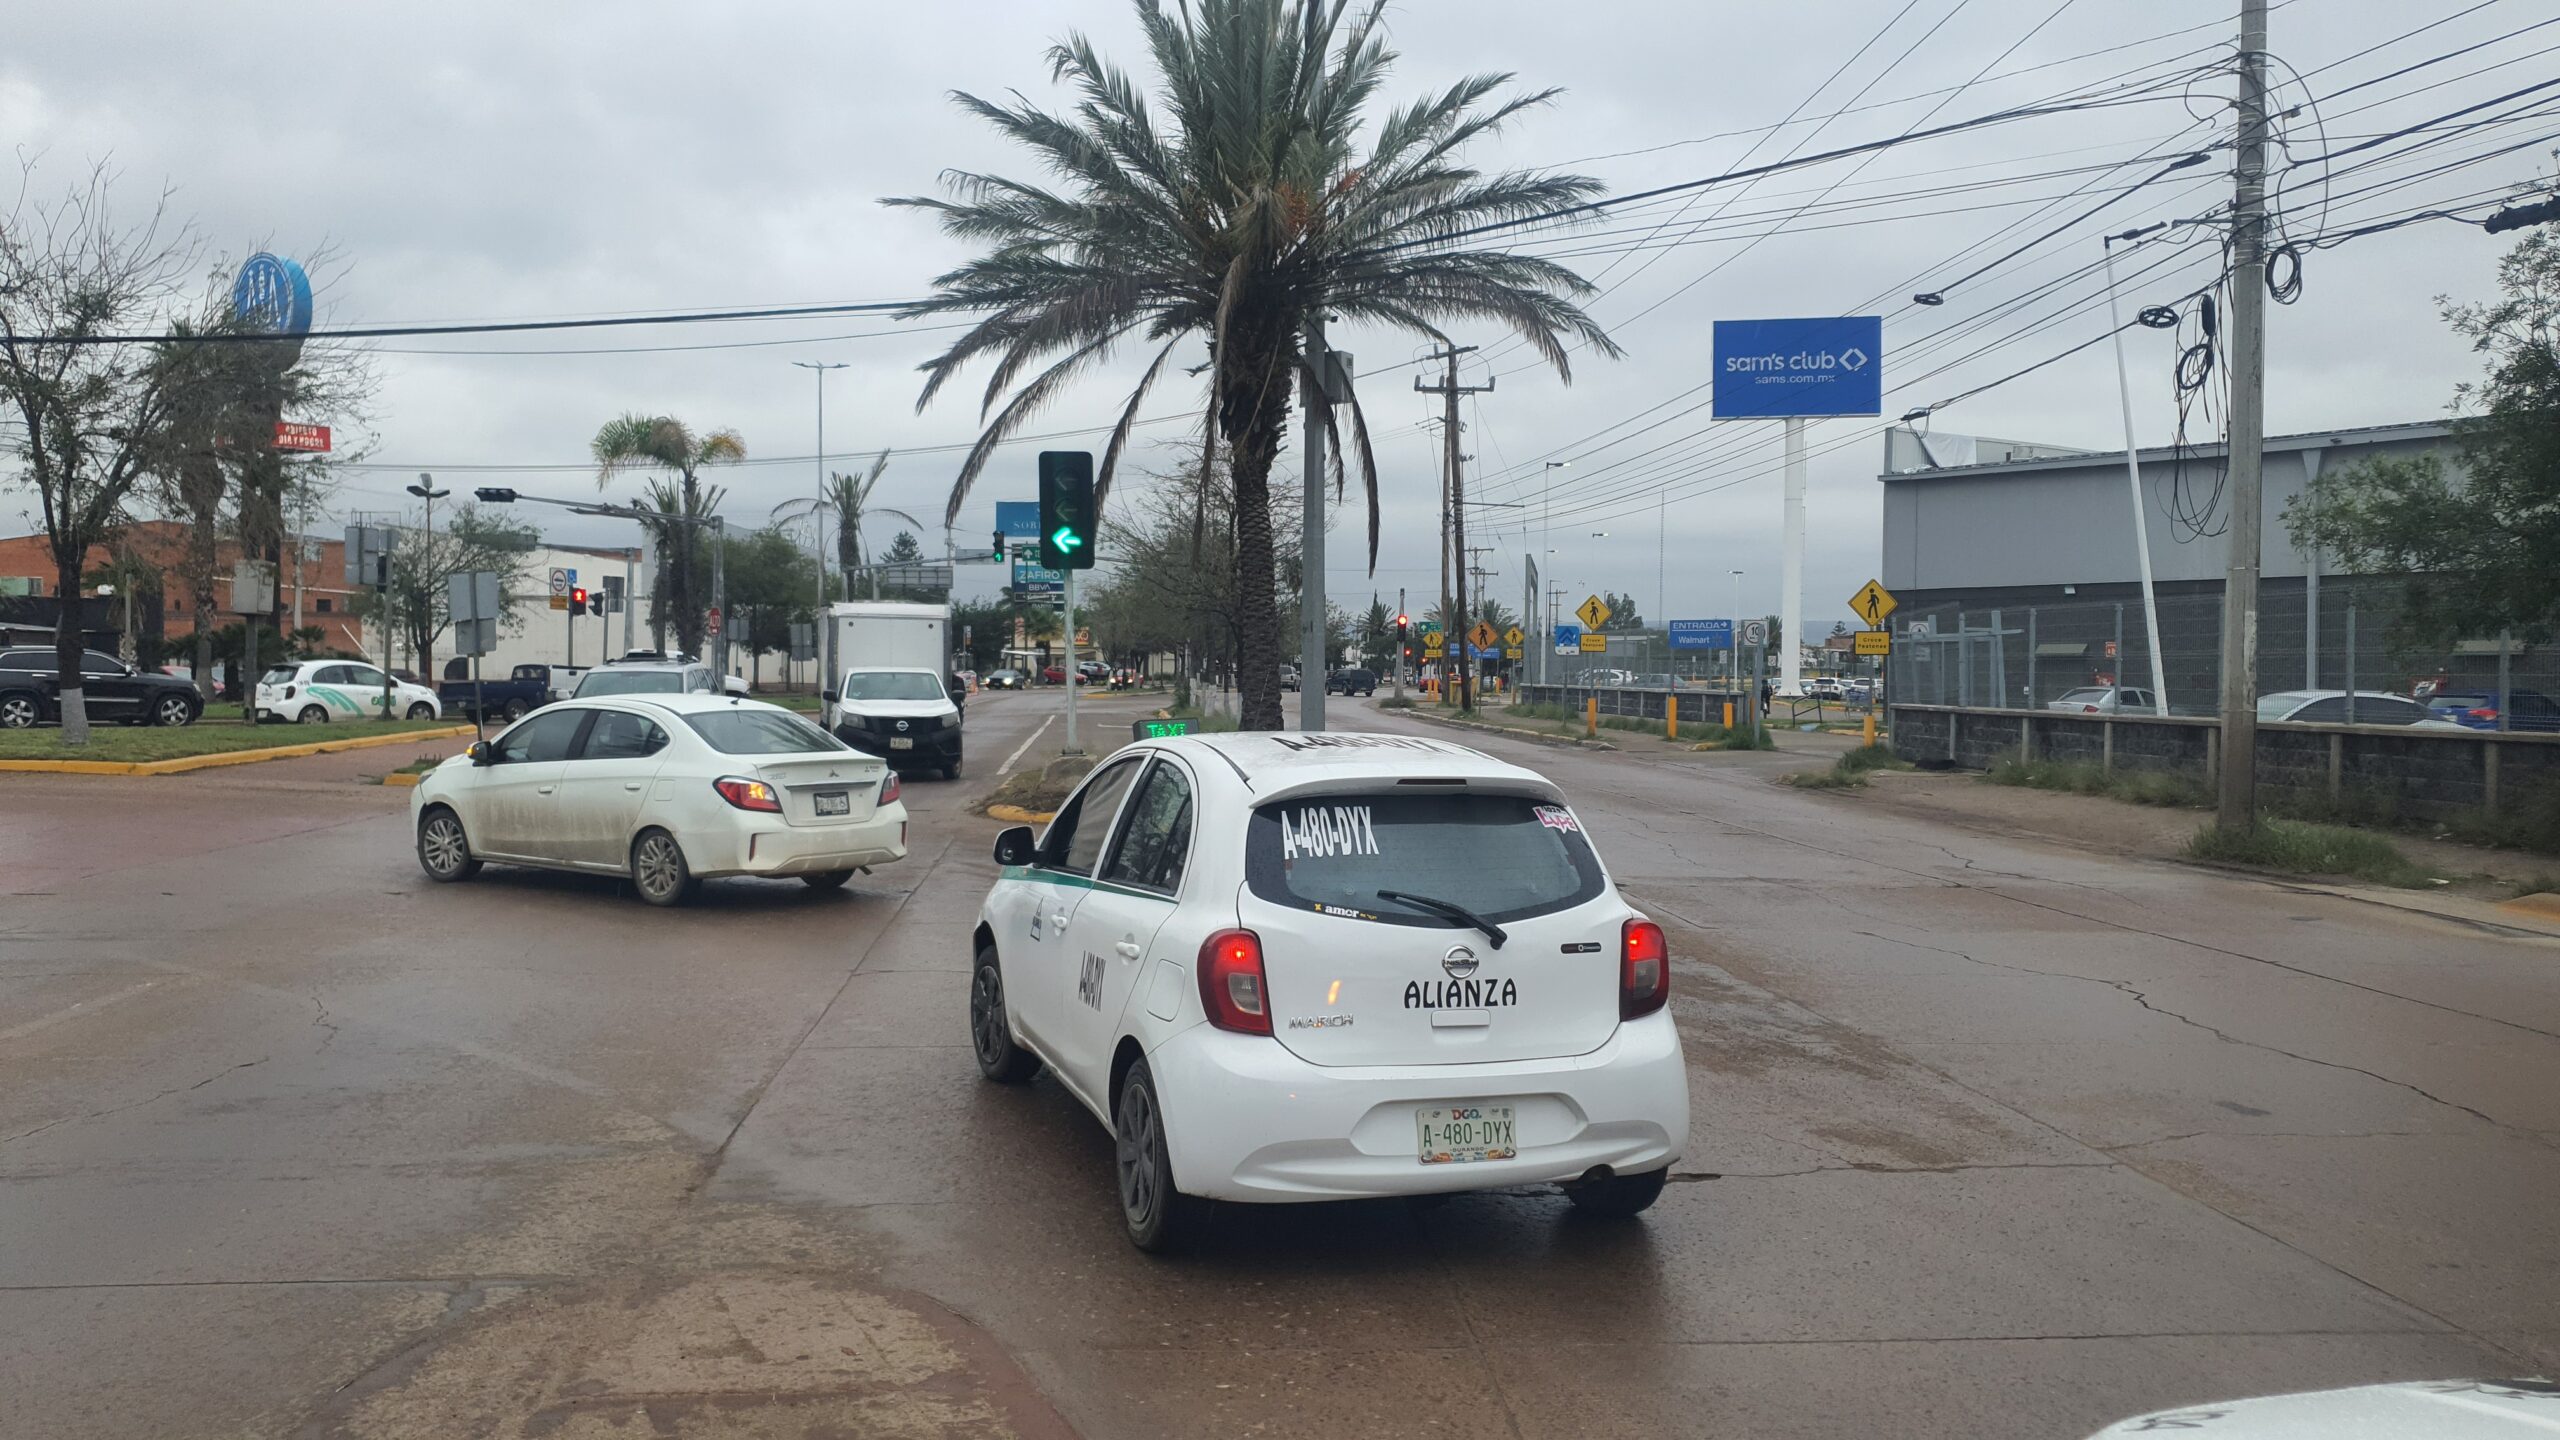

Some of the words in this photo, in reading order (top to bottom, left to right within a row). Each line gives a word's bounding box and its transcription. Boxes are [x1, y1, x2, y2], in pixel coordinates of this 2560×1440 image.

[1726, 352, 1785, 372] sam's
[1789, 351, 1836, 370] club
[1755, 374, 1835, 384] sams.com.mx
[1019, 570, 1060, 580] ZAFIRO
[1028, 583, 1051, 591] BBVA
[1678, 636, 1710, 644] Walmart
[1146, 723, 1185, 737] TAXI
[1281, 806, 1380, 860] A-480-DYX
[1404, 978, 1517, 1008] ALIANZA
[1289, 1013, 1354, 1029] MARCH
[1423, 1121, 1513, 1147] A-480-DYX
